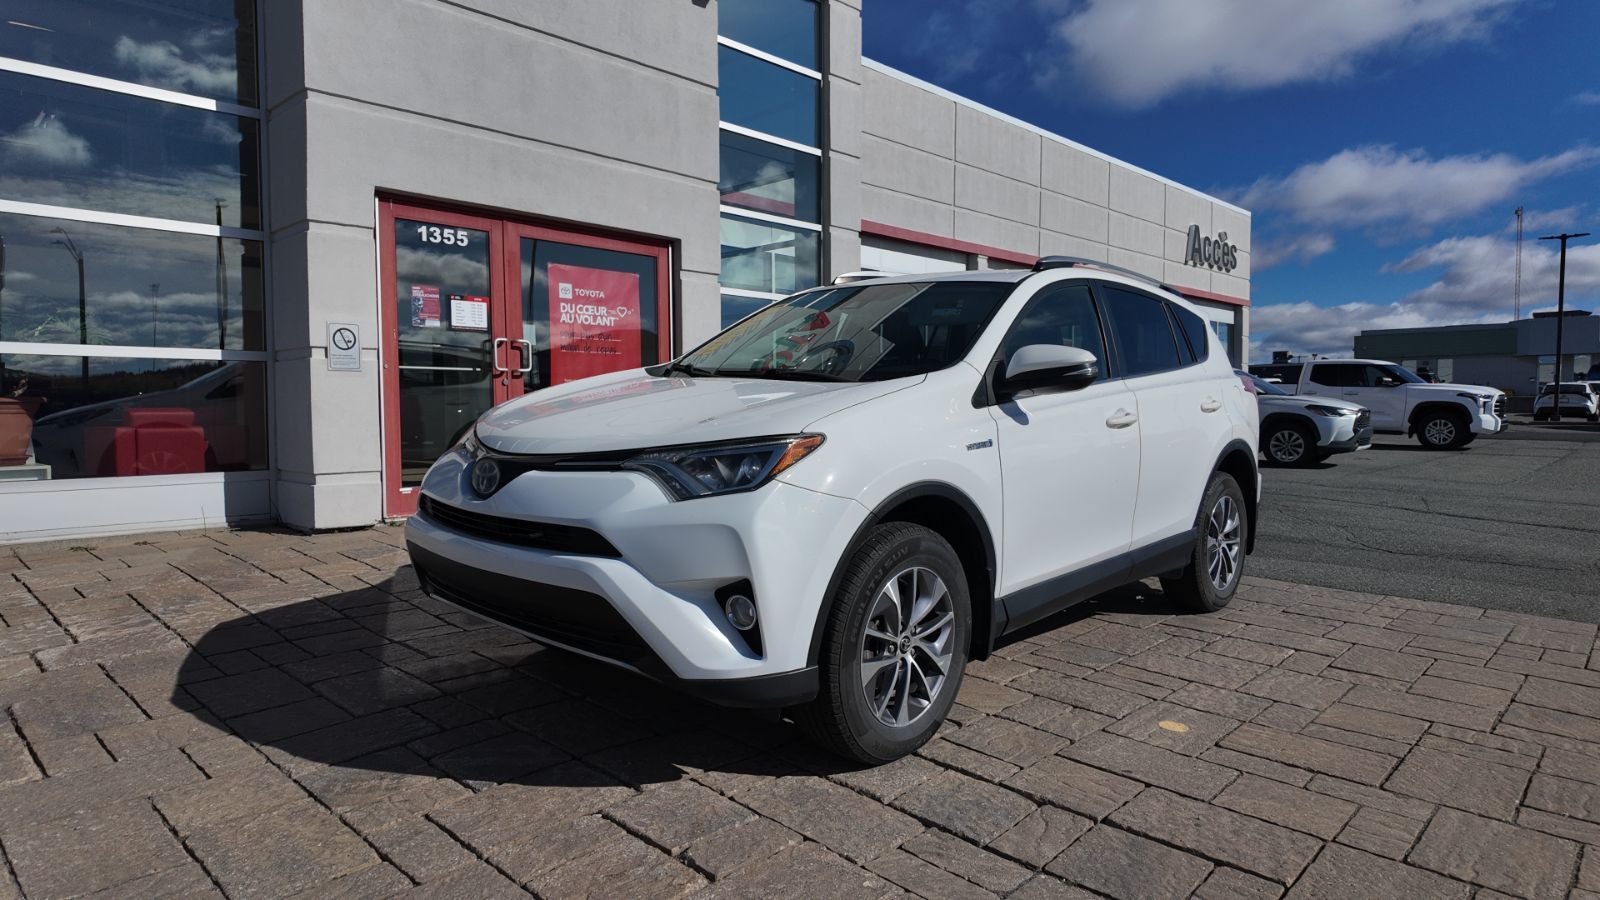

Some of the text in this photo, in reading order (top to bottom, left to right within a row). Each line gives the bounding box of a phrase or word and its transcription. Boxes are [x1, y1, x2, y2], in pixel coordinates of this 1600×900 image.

[417, 225, 469, 247] 1355
[1184, 224, 1238, 272] Accès
[574, 288, 605, 299] TOYOTA
[560, 303, 607, 316] DU CŒUR
[560, 313, 616, 327] AU VOLANT
